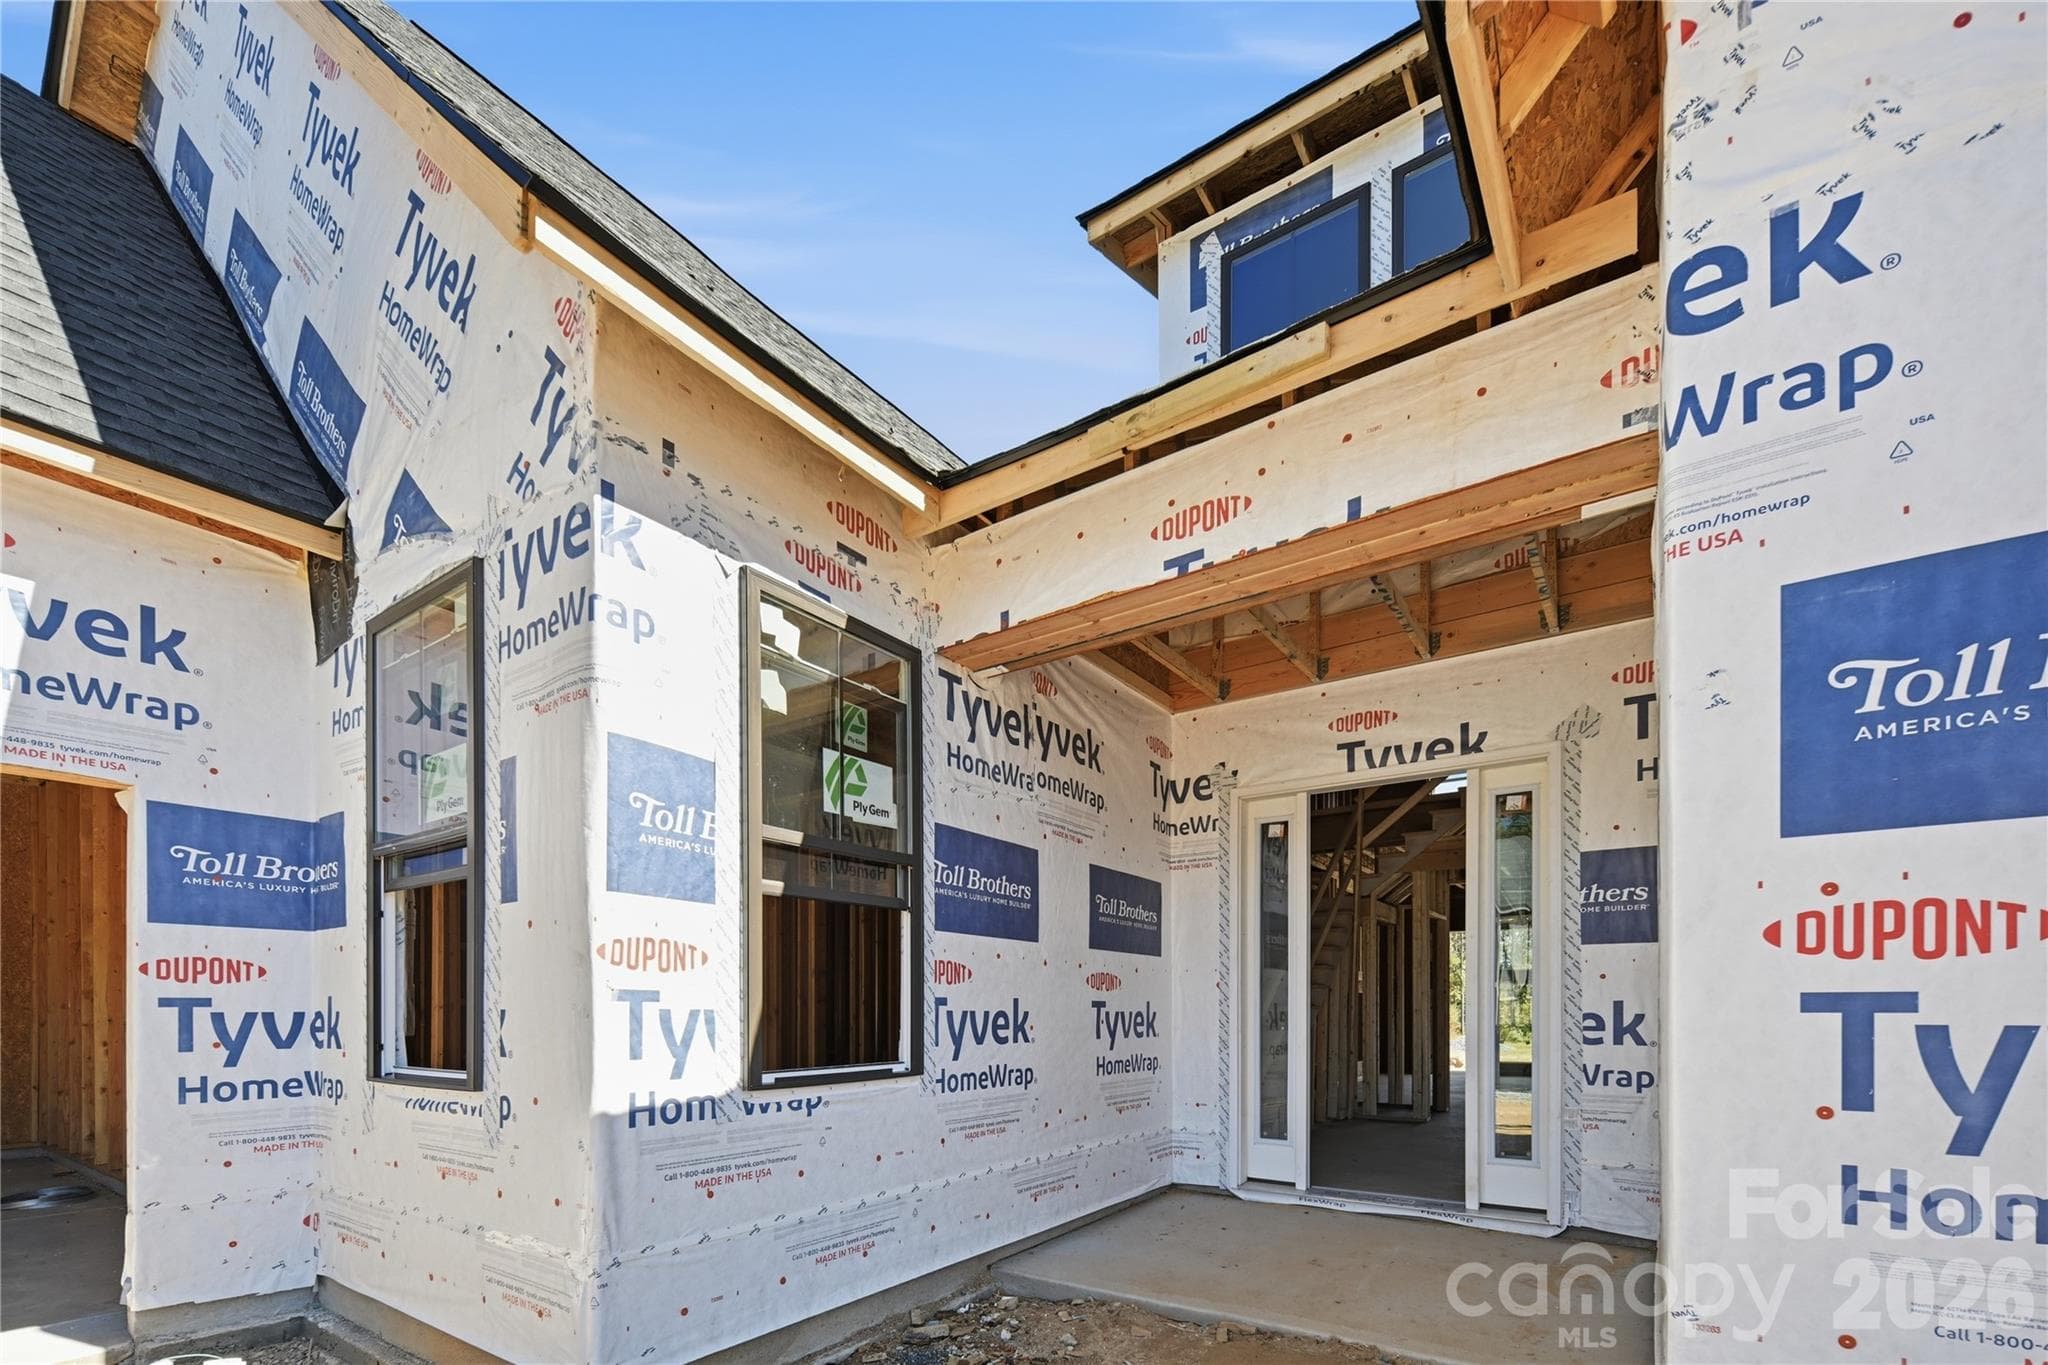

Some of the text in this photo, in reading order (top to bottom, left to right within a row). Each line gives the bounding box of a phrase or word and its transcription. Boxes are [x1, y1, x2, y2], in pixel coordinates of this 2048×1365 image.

[1800, 16, 1824, 31] USA
[234, 3, 275, 96] Tyvek
[224, 78, 263, 150] HomeWrap
[302, 81, 361, 197] Tyvek
[1818, 171, 1851, 196] Tyvek
[289, 164, 345, 255] HomeWrap
[1685, 218, 1714, 244] Tyvek
[395, 189, 479, 334] Tyvek
[378, 280, 452, 395] HomeWrap
[296, 360, 315, 402] Toll
[310, 386, 347, 458] Brothers
[1909, 413, 1936, 426] USA
[836, 501, 891, 552] DUPONT
[1162, 495, 1241, 542] DUPONT
[1697, 528, 1744, 553] USA
[794, 541, 856, 592] DUPONT
[499, 586, 656, 664] HomeWrap
[1827, 638, 2012, 715] Toll
[1031, 702, 1105, 774] yvek
[1336, 709, 1391, 733] DUPONT
[1854, 704, 2031, 742] AMERICA'S
[4, 745, 127, 772] MADE IN THE USA
[60, 743, 162, 767] tyvek.com/homewrap
[1036, 770, 1105, 813] omeWrap
[1150, 760, 1213, 812] Tyve
[629, 791, 695, 836] Toll
[852, 800, 890, 819] Ply Gem
[639, 833, 701, 854] AMERICA'S
[170, 845, 338, 883] Toll Broers
[934, 859, 1032, 900] Toll Brothers
[182, 876, 255, 890] AMERICA'S
[259, 883, 306, 894] LUXURY
[934, 887, 1032, 910] AMERICA'S LUXURY HOME BUILDER
[1095, 894, 1158, 923] Toll Brothers
[1604, 903, 1647, 912] BUILDER
[1796, 897, 2027, 961] DUPONT
[155, 956, 254, 985] DUPONT
[610, 937, 698, 973] DUPONT
[1089, 971, 1119, 993] DUPONT
[158, 996, 342, 1068] Tyvek
[934, 997, 1031, 1062] Tyvek
[1091, 1000, 1158, 1051] Tyvek
[935, 1063, 1034, 1093] HomeWrap
[1096, 1053, 1159, 1077] HomeWrap
[1800, 991, 2042, 1158] Ty
[177, 1071, 344, 1105] HomeWrap
[218, 1139, 234, 1147] Call
[1582, 1123, 1600, 1131] USA
[253, 1142, 287, 1153] MADE
[288, 1140, 300, 1150] IN
[664, 1154, 798, 1182] Call 1-800-448-9835 tyvek.com/homewrap
[695, 1168, 772, 1190] MADE IN THE USA
[815, 1253, 837, 1265] MADE
[848, 1246, 861, 1256] THE
[862, 1240, 876, 1252] USA
[1934, 1325, 1971, 1342] Call
